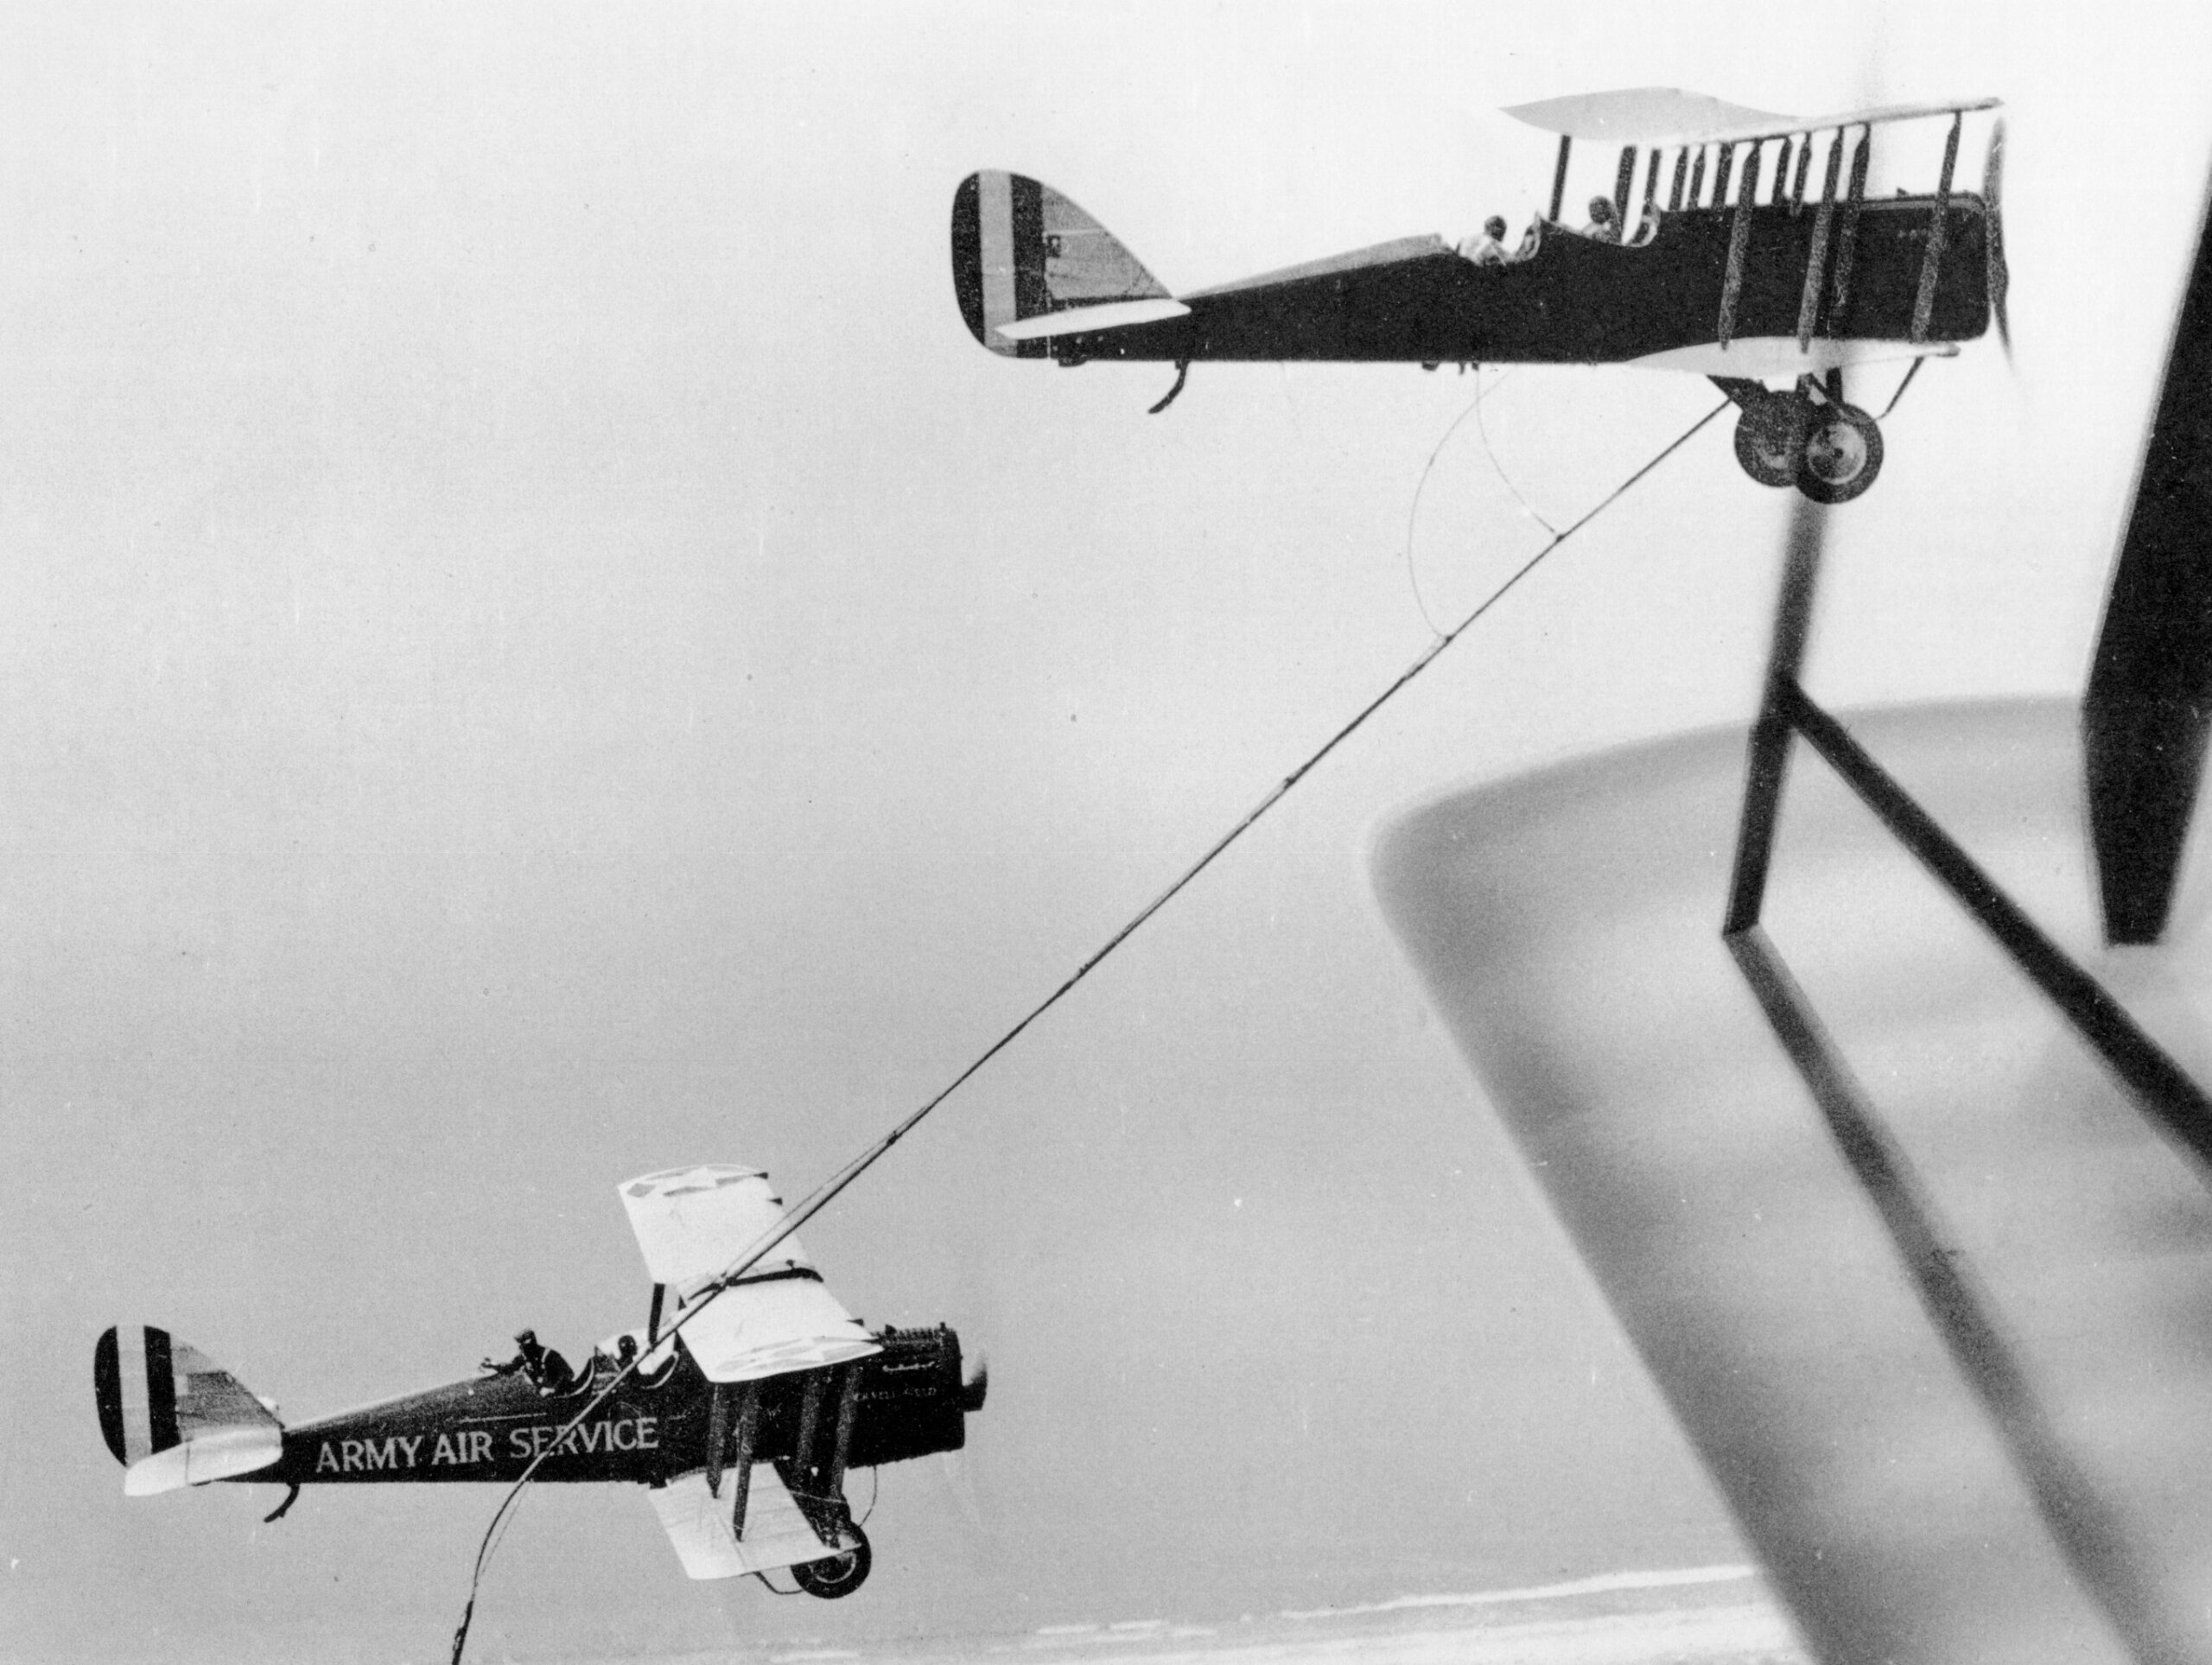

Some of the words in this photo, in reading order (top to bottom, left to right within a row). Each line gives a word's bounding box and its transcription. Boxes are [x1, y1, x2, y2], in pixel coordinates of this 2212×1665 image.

[316, 1435, 423, 1472] ARMY
[432, 1431, 494, 1465] AIR
[509, 1417, 658, 1458] SERVICE
